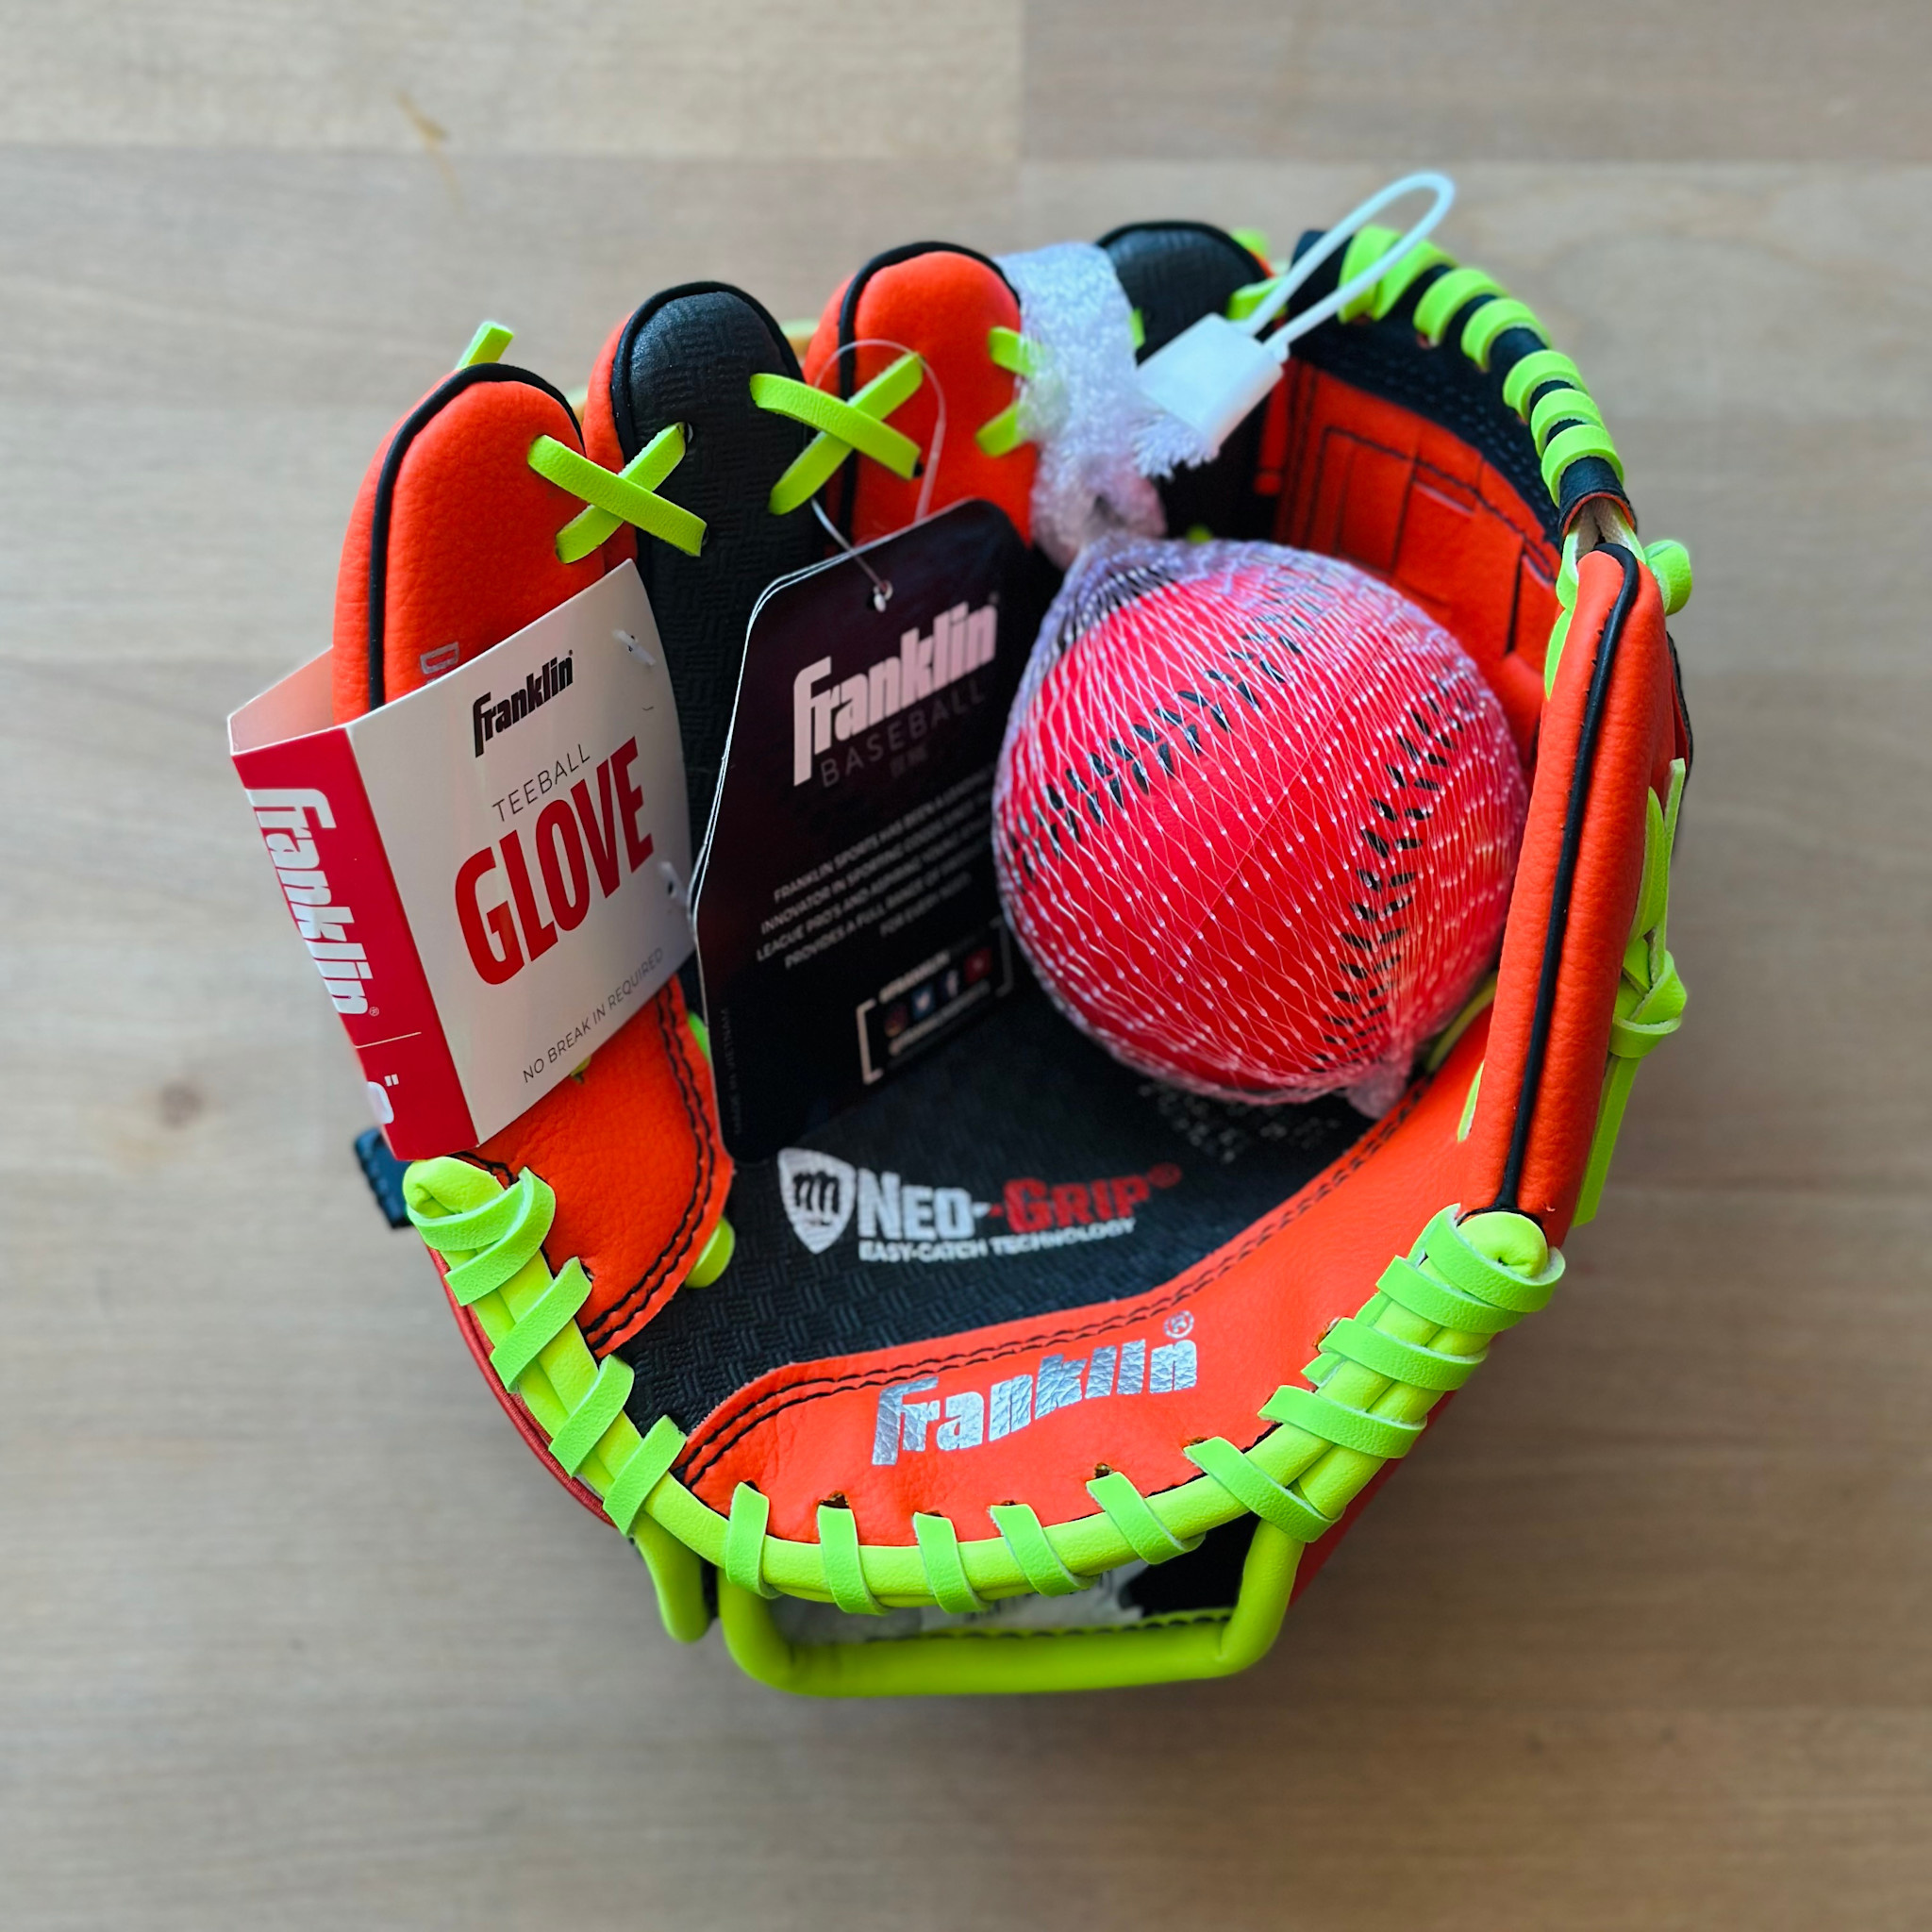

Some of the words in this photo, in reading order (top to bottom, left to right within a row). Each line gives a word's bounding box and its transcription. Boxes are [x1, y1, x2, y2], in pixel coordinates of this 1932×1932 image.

[491, 743, 591, 823] TEEBALL
[820, 676, 986, 789] BASEBALL
[454, 735, 656, 986] GLOVE
[523, 1058, 545, 1083] NO
[547, 1016, 591, 1064] BREAK
[591, 1004, 607, 1025] IN
[607, 946, 664, 1011] REQUIRED
[858, 1239, 990, 1263] EASY-CATCH
[990, 1216, 1136, 1257] TECHNOLOGY
